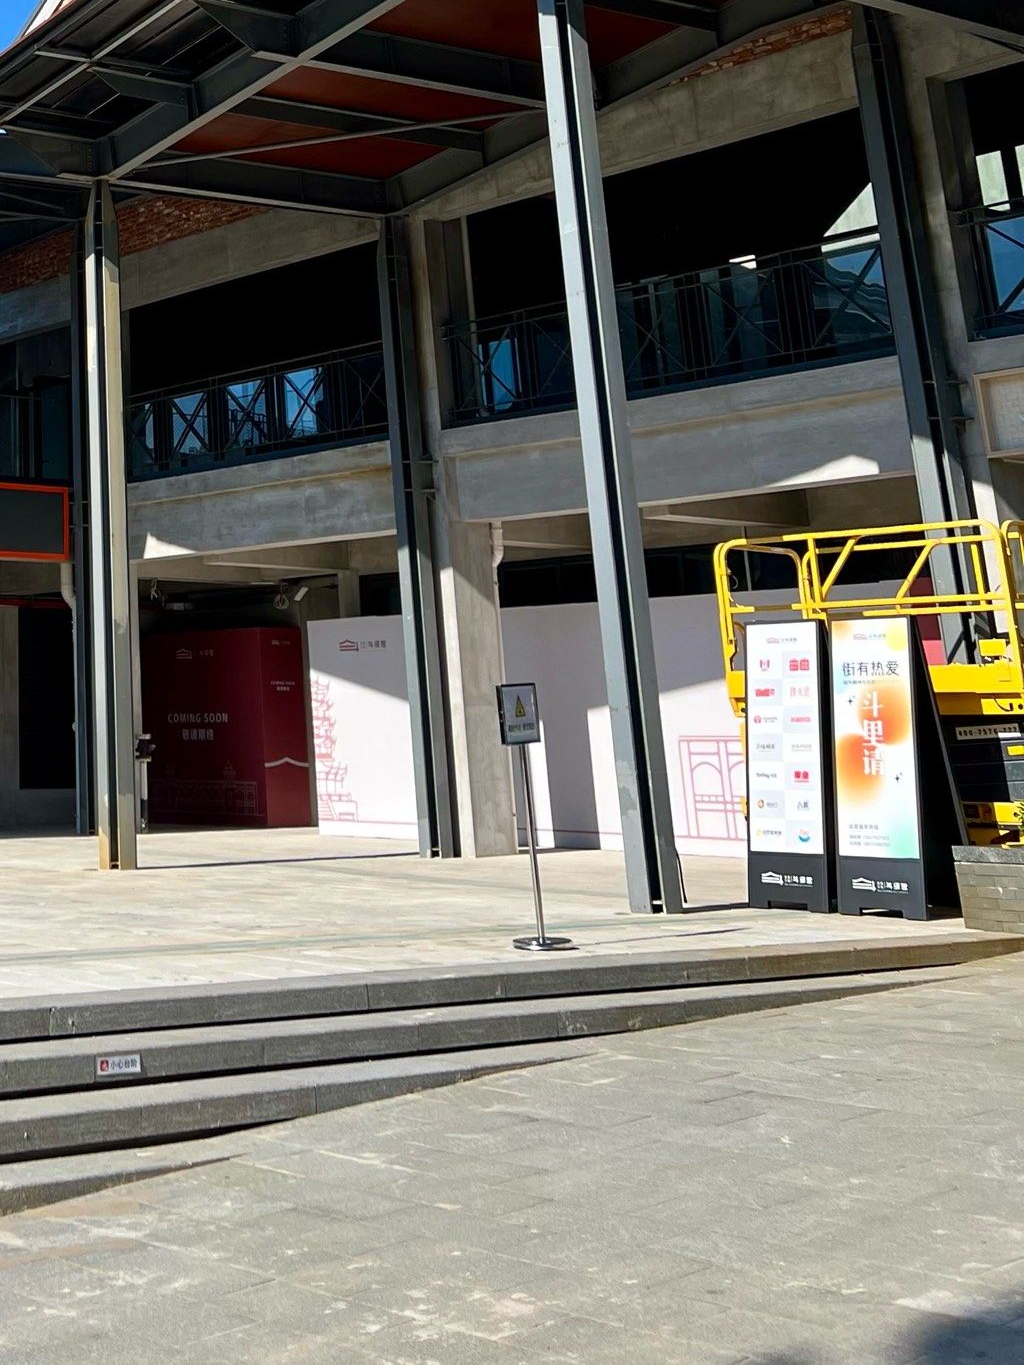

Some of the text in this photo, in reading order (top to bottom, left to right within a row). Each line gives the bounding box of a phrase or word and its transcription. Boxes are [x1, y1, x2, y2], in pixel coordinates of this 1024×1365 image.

[842, 660, 900, 677] 街有热爱
[167, 713, 229, 723] COMING SOON
[110, 1058, 138, 1071] 小心台阶
